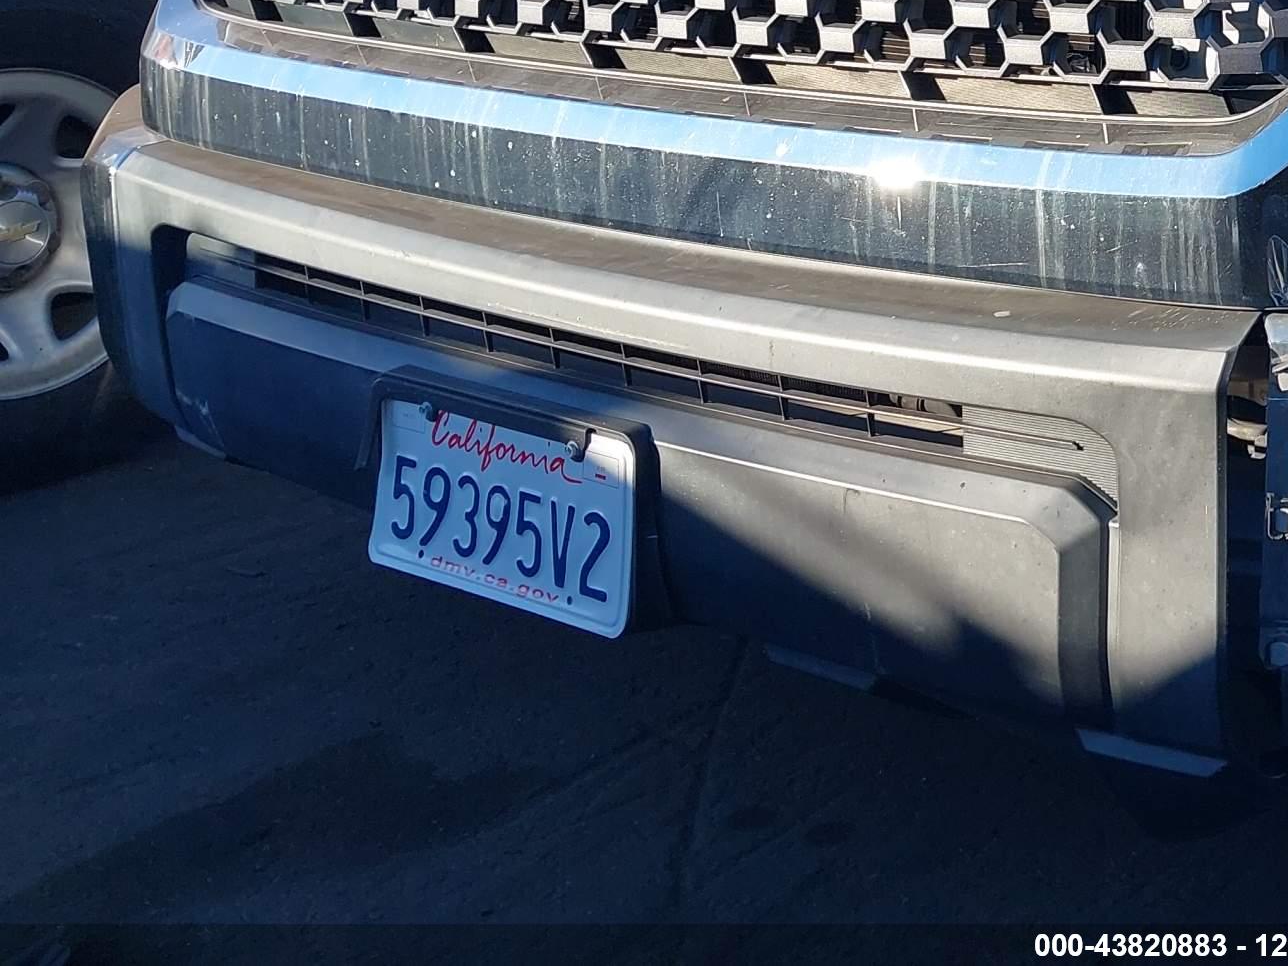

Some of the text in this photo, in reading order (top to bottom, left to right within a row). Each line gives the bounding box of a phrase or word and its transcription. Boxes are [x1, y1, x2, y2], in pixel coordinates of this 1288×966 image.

[431, 410, 583, 483] California
[390, 455, 611, 603] 59395V2
[430, 555, 560, 603] dmv.ca.gov
